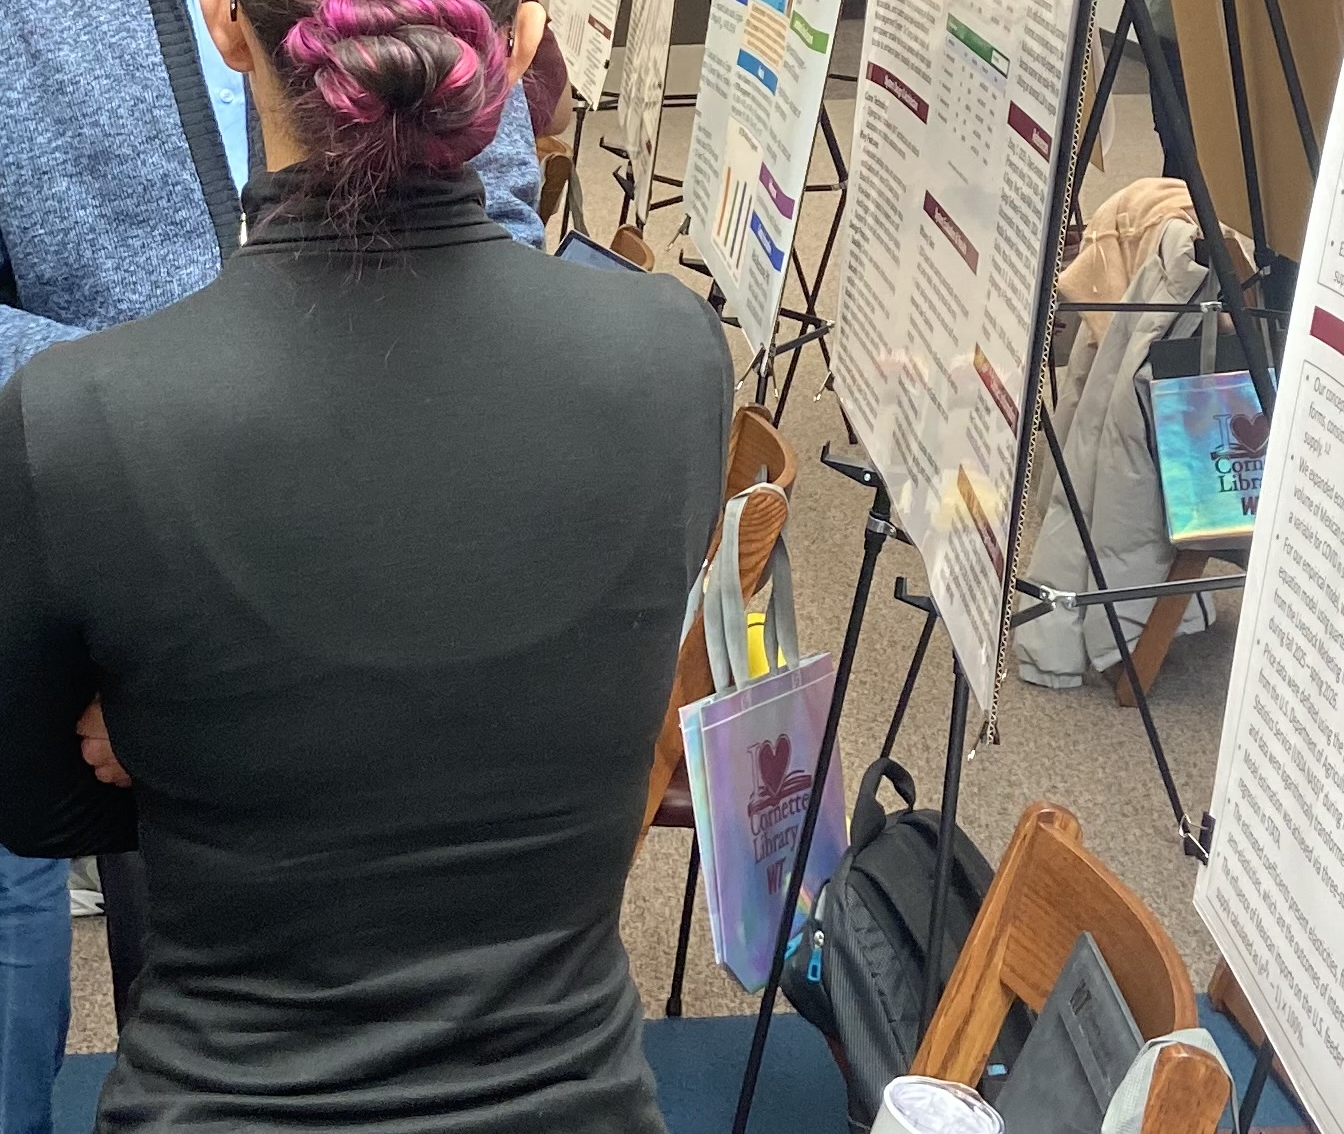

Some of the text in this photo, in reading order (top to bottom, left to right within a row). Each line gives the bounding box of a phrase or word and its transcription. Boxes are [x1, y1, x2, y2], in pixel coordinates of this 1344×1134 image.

[1215, 457, 1264, 474] Corn
[1218, 474, 1263, 493] Libr
[750, 793, 810, 836] Cornette
[752, 823, 799, 865] Library
[766, 856, 787, 895] WT
